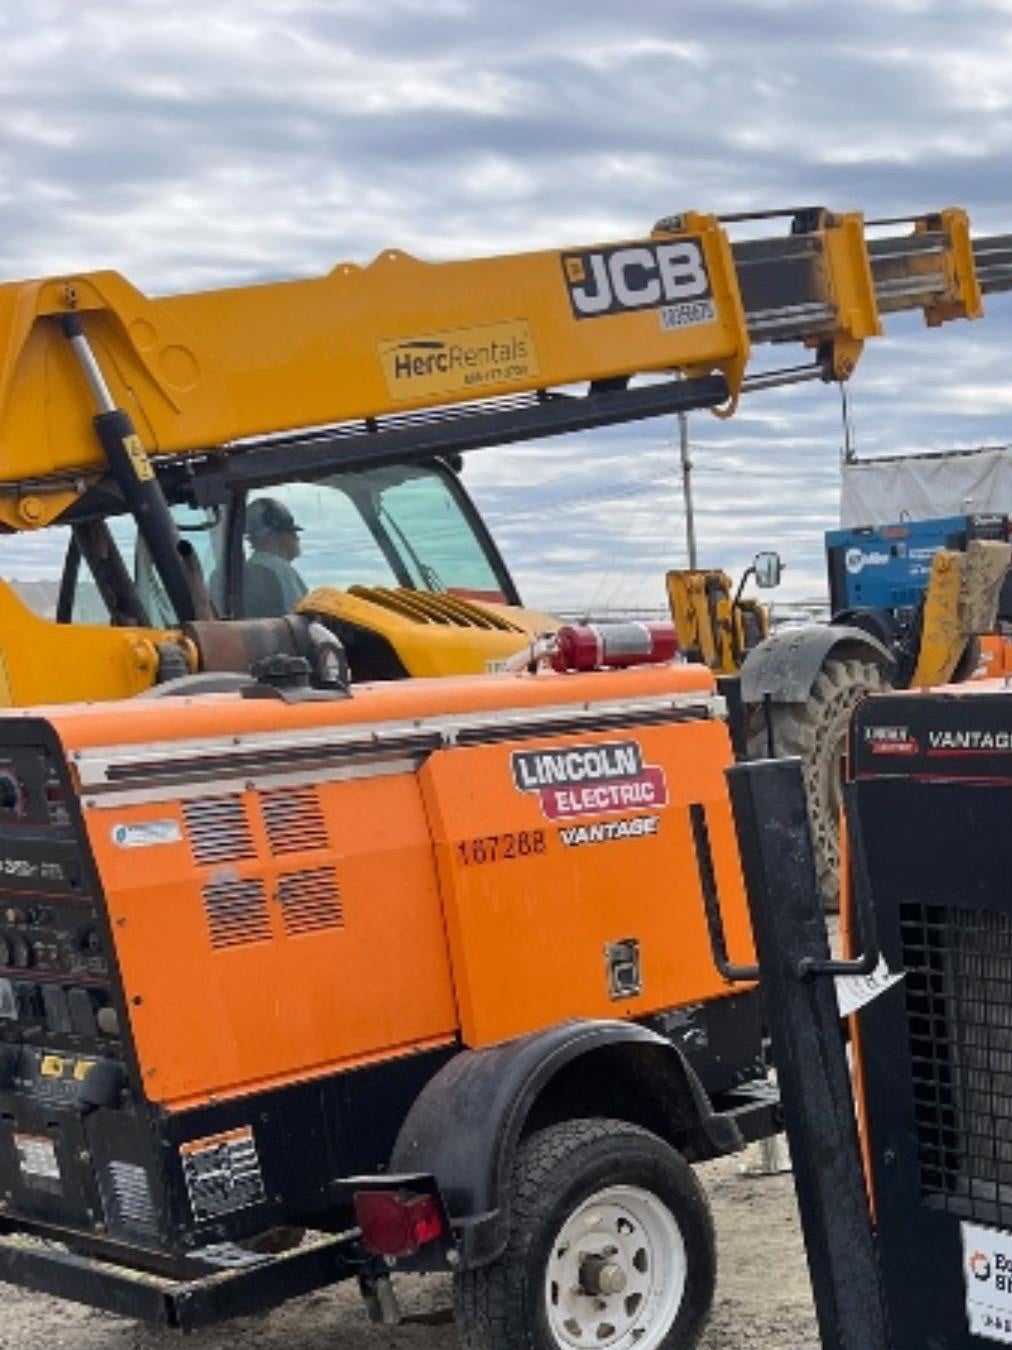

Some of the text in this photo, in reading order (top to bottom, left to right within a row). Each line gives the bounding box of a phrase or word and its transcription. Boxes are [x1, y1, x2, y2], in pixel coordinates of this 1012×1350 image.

[572, 242, 709, 313] JCB
[518, 746, 638, 786] LINCOLN
[554, 782, 656, 812] ELECTRIC
[560, 815, 660, 846] VANTAGE
